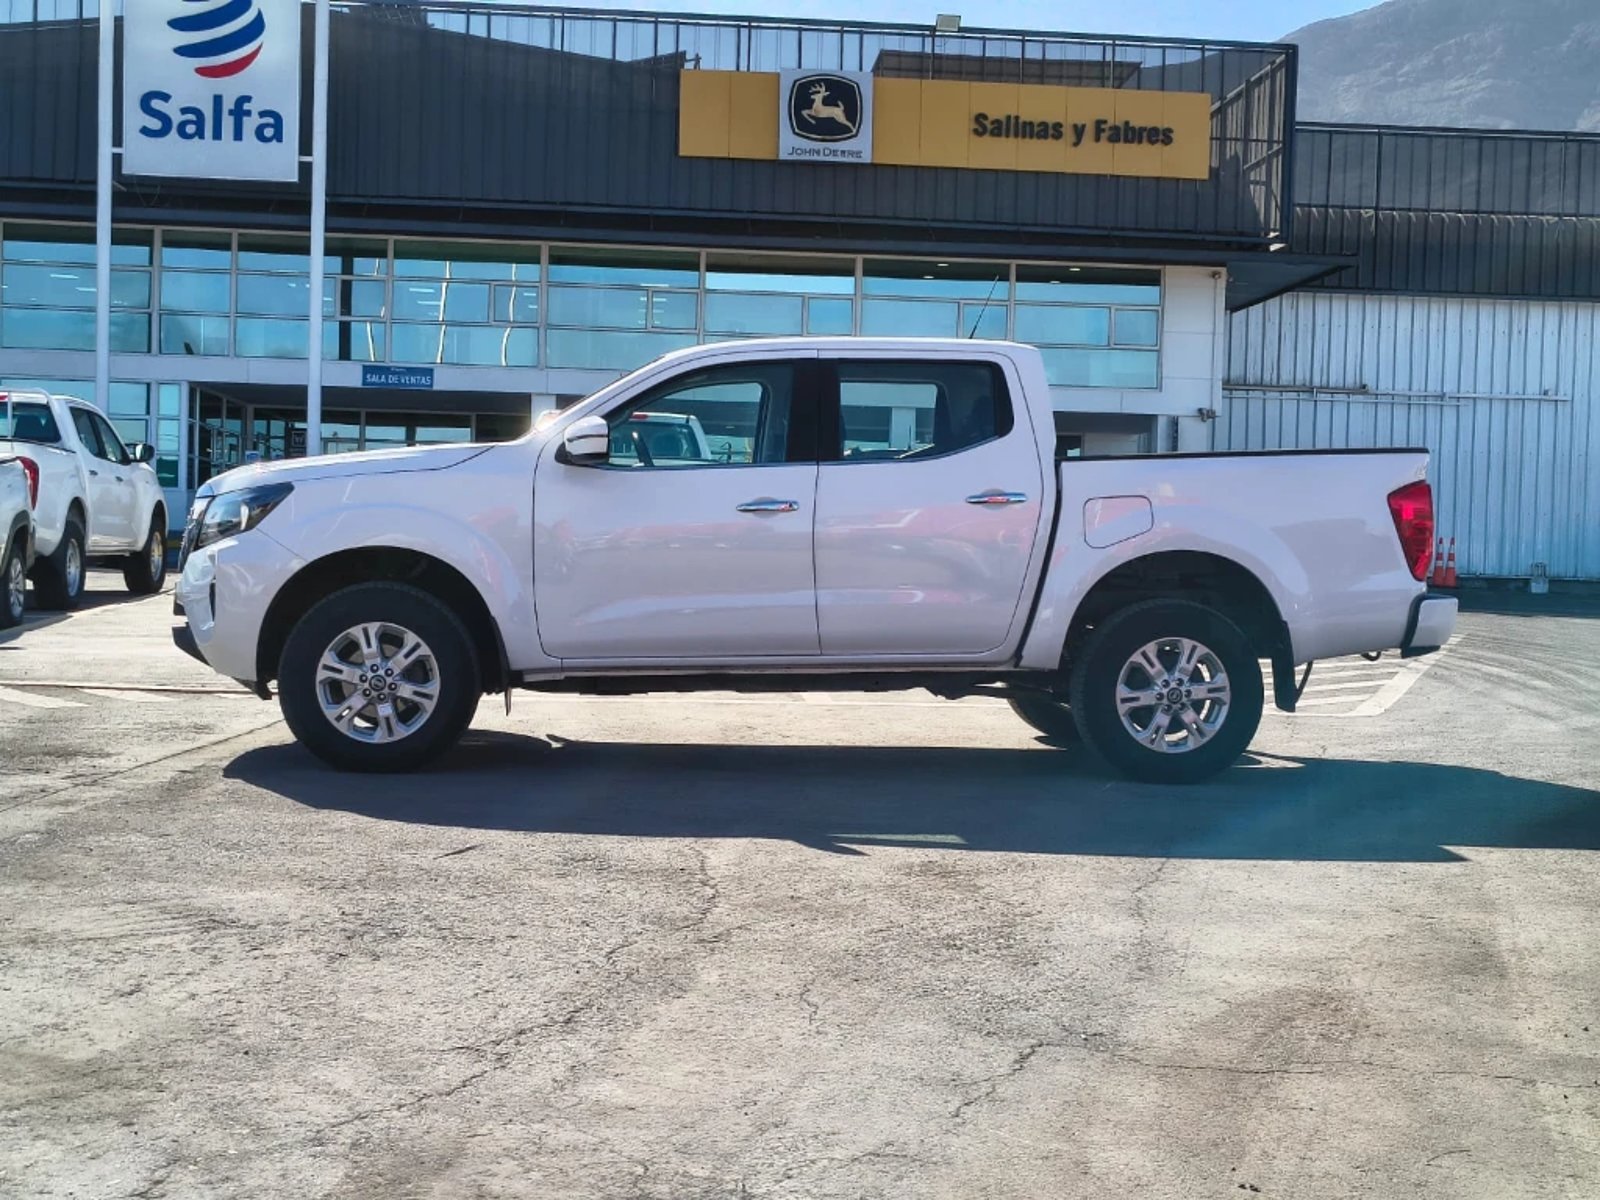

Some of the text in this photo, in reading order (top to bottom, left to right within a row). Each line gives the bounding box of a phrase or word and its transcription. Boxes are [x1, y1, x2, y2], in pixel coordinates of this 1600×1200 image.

[138, 90, 284, 143] Salfa
[972, 112, 1175, 147] Salinas y Fabres
[787, 146, 821, 157] JOHN
[366, 373, 432, 386] SALA DE VENTAS
